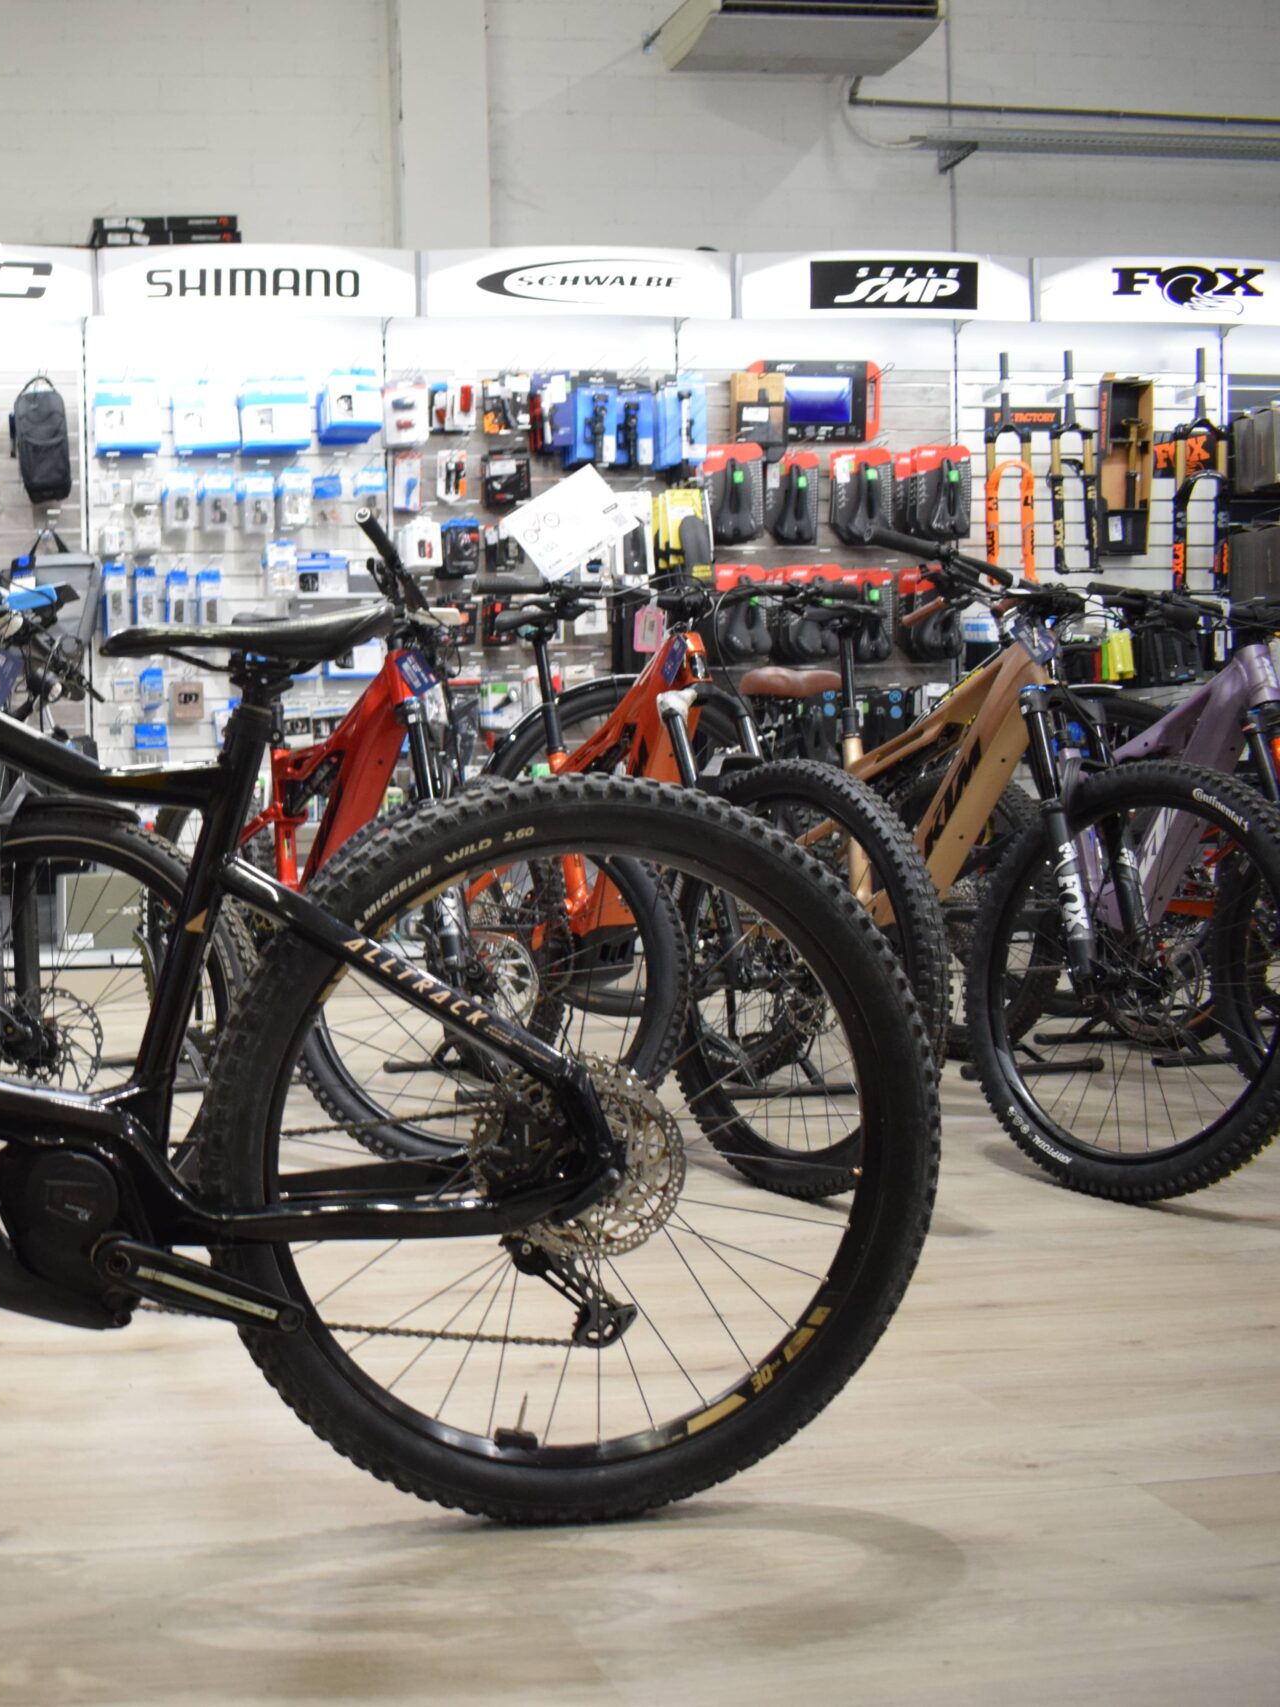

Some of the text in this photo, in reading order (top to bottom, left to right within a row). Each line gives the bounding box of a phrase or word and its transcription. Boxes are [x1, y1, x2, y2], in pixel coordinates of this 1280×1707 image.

[146, 268, 360, 298] SHIMANO
[517, 274, 681, 289] SCHWALBE
[834, 277, 960, 303] SMP
[856, 267, 960, 278] SELLE
[1112, 266, 1265, 308] FOX
[1153, 435, 1210, 470] FX
[1192, 787, 1244, 828] Continental
[363, 825, 536, 921] MICHELIN WILD 2.60
[1057, 872, 1091, 933] FOX
[344, 937, 490, 1027] ALLTRACK
